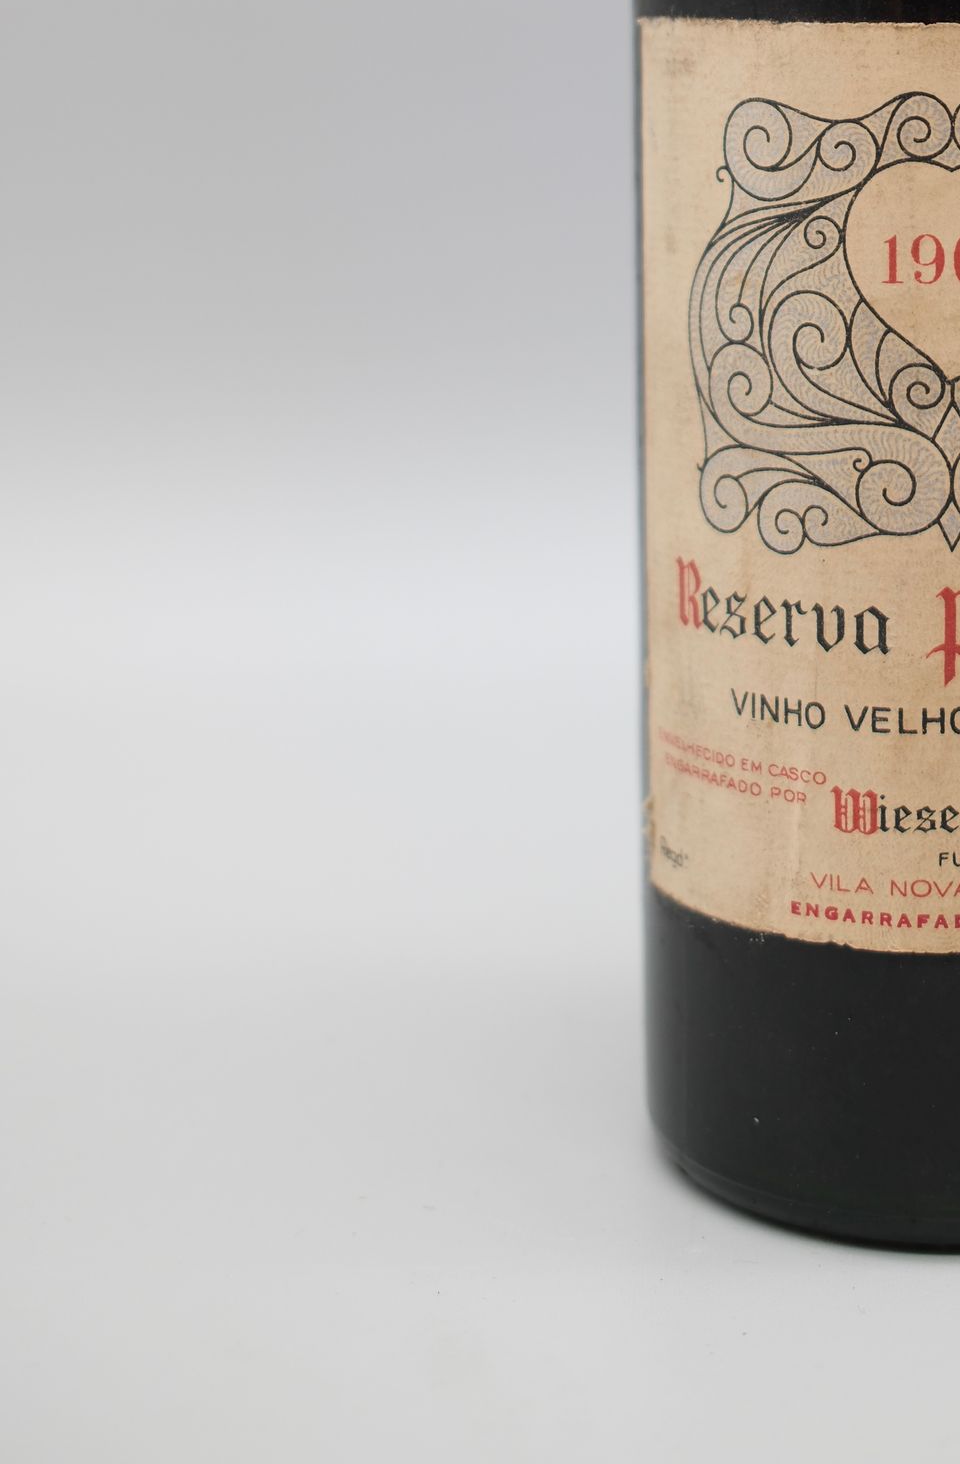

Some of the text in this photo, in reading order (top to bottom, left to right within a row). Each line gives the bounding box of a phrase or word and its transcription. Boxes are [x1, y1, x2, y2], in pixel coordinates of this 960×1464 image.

[676, 556, 892, 655] Reserva
[731, 687, 826, 730] VINHO
[741, 758, 762, 775] EM
[768, 764, 827, 785] CASCO
[770, 786, 807, 804] POR
[830, 785, 960, 836] Wiese
[809, 872, 874, 895] VILA
